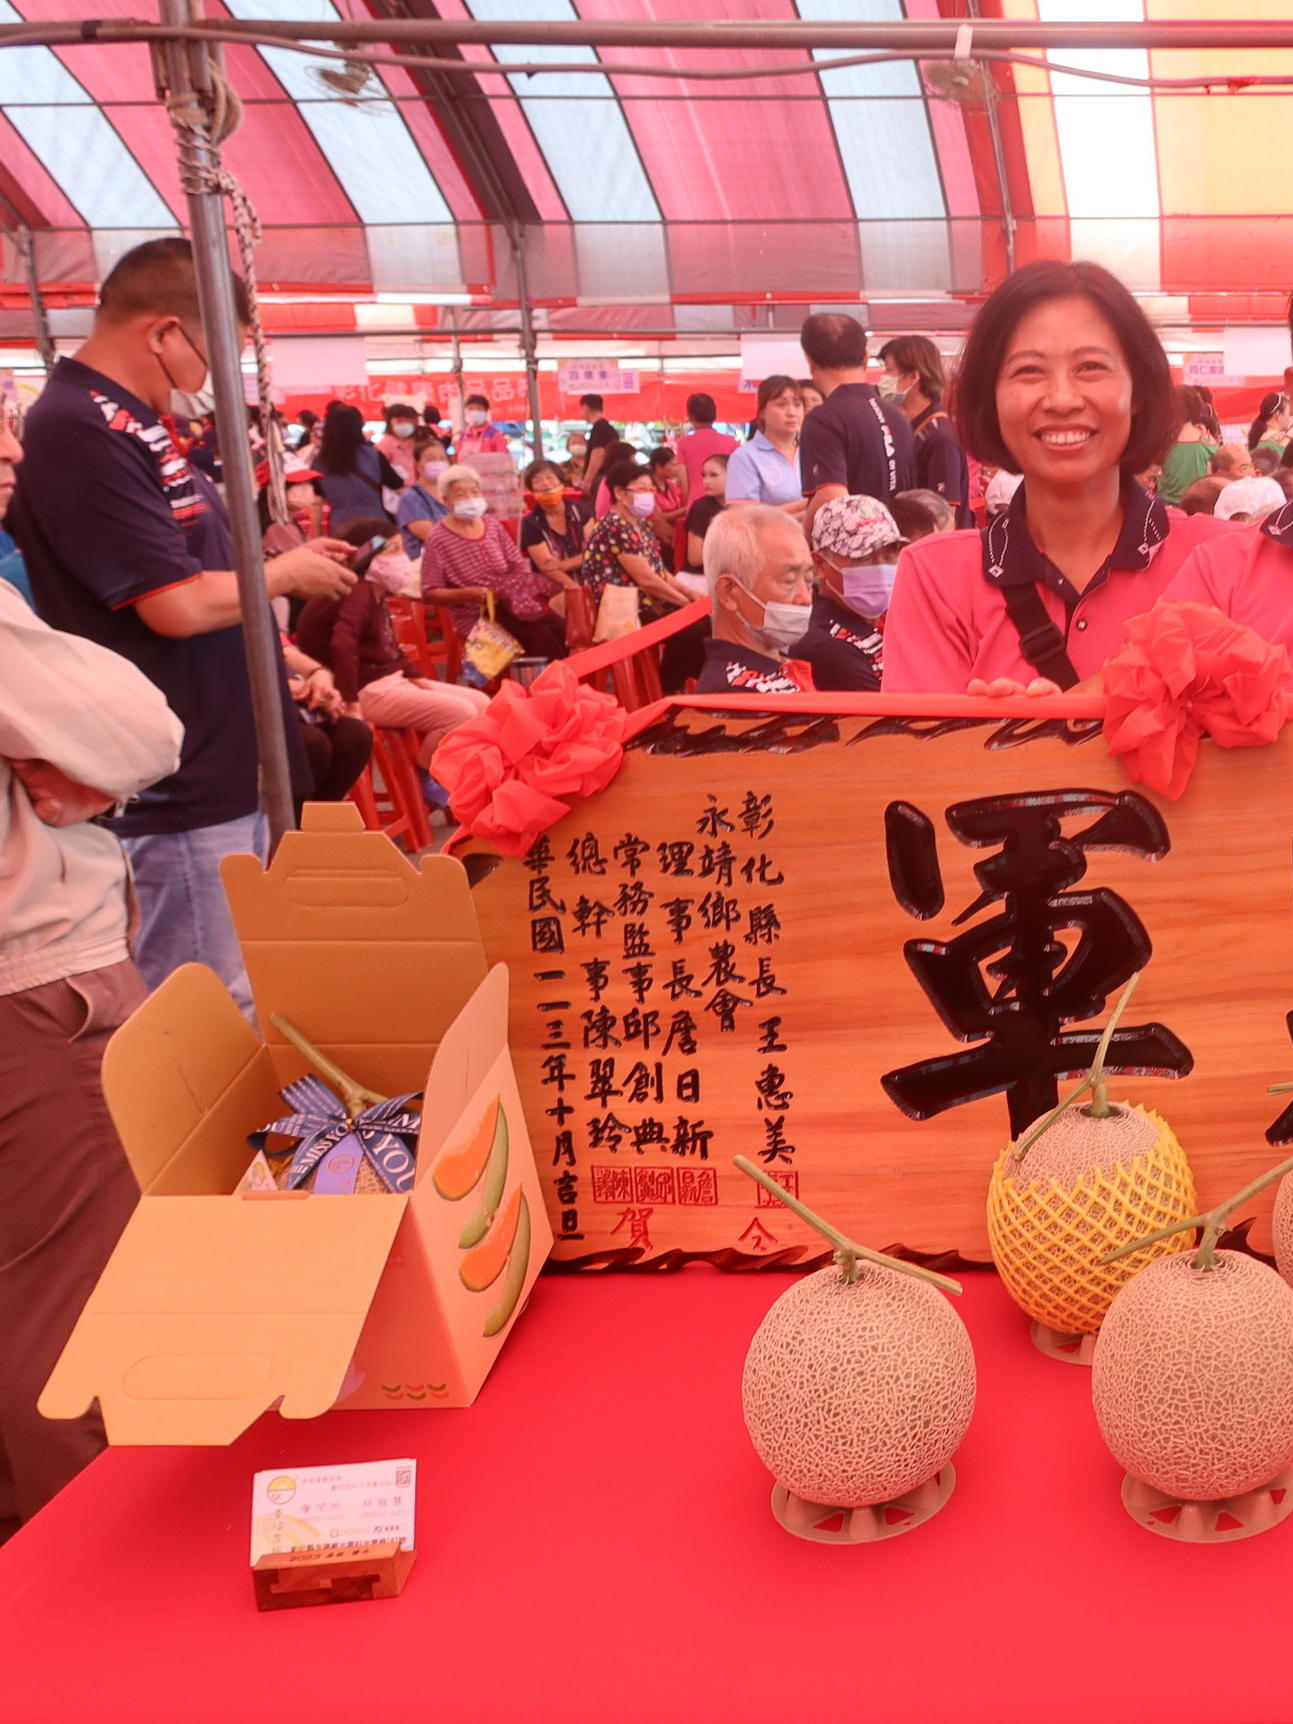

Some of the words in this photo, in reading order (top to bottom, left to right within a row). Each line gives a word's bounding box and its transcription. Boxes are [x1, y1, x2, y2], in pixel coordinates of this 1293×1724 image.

[697, 795, 752, 1032] 永靖鄉農會
